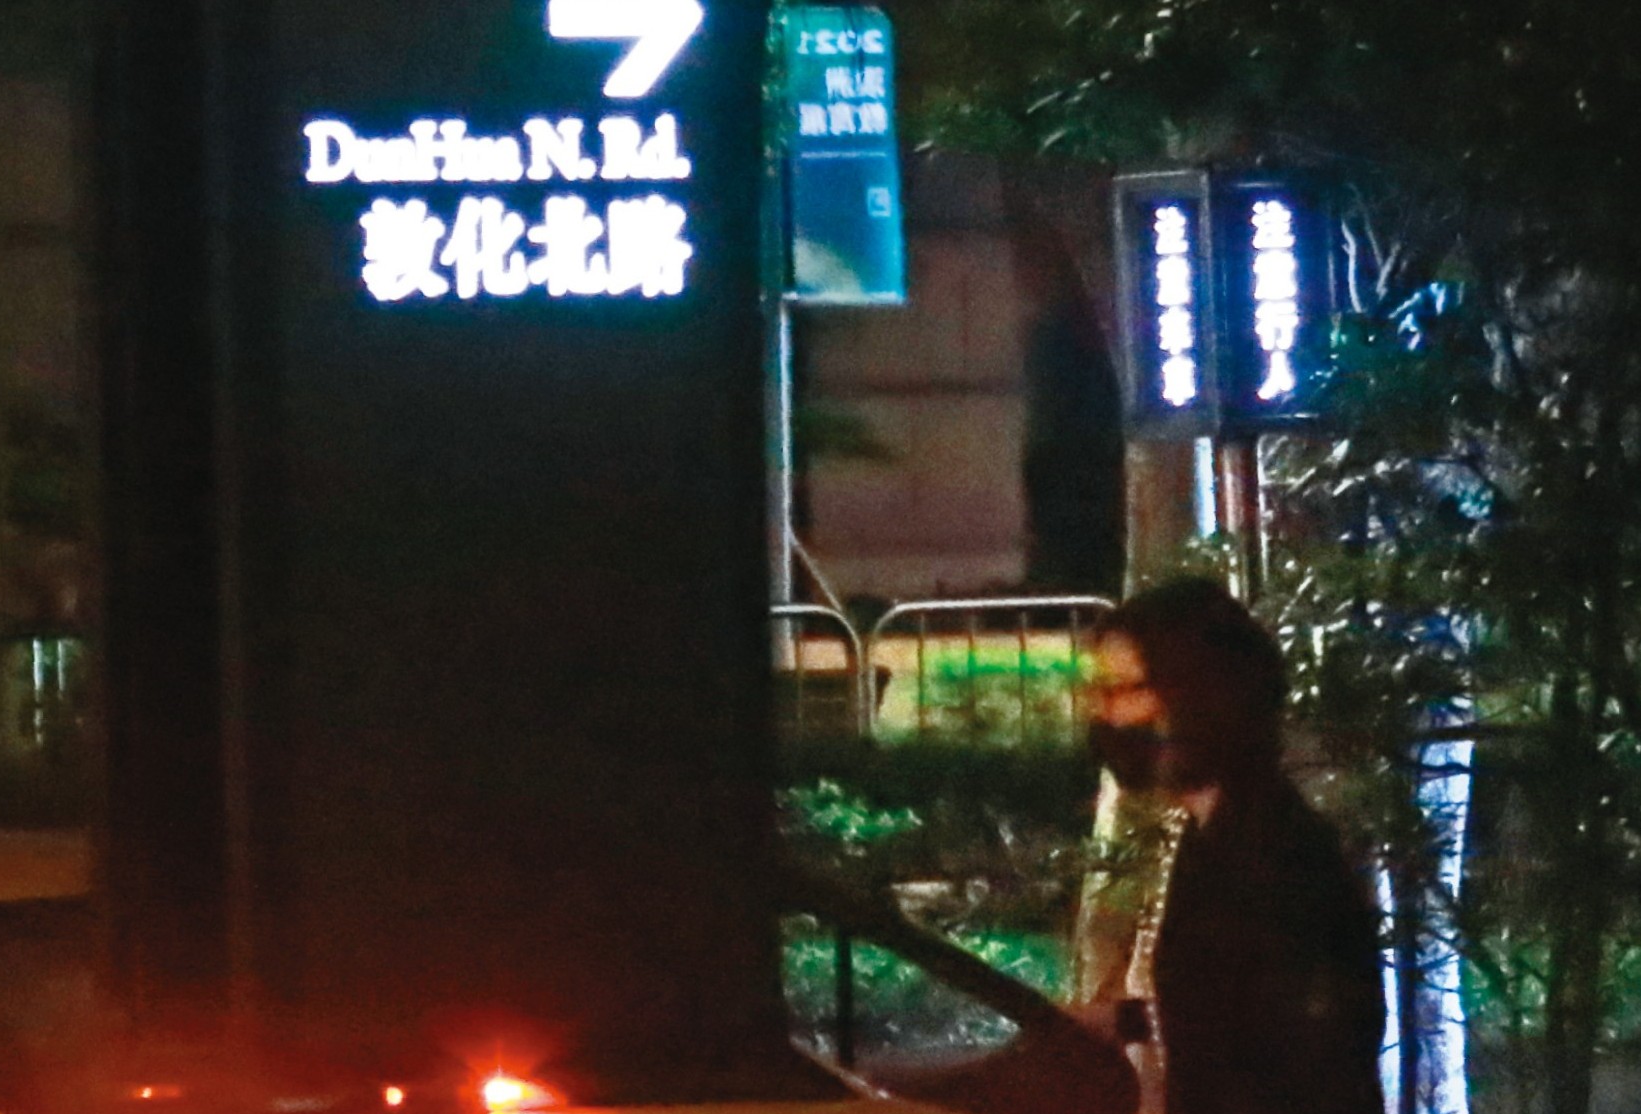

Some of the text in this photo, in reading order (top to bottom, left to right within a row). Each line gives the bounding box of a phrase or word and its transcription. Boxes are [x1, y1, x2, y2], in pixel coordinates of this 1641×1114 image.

[523, 117, 596, 180] N.
[599, 113, 691, 179] Rd.
[360, 195, 692, 300] 敦化北路
